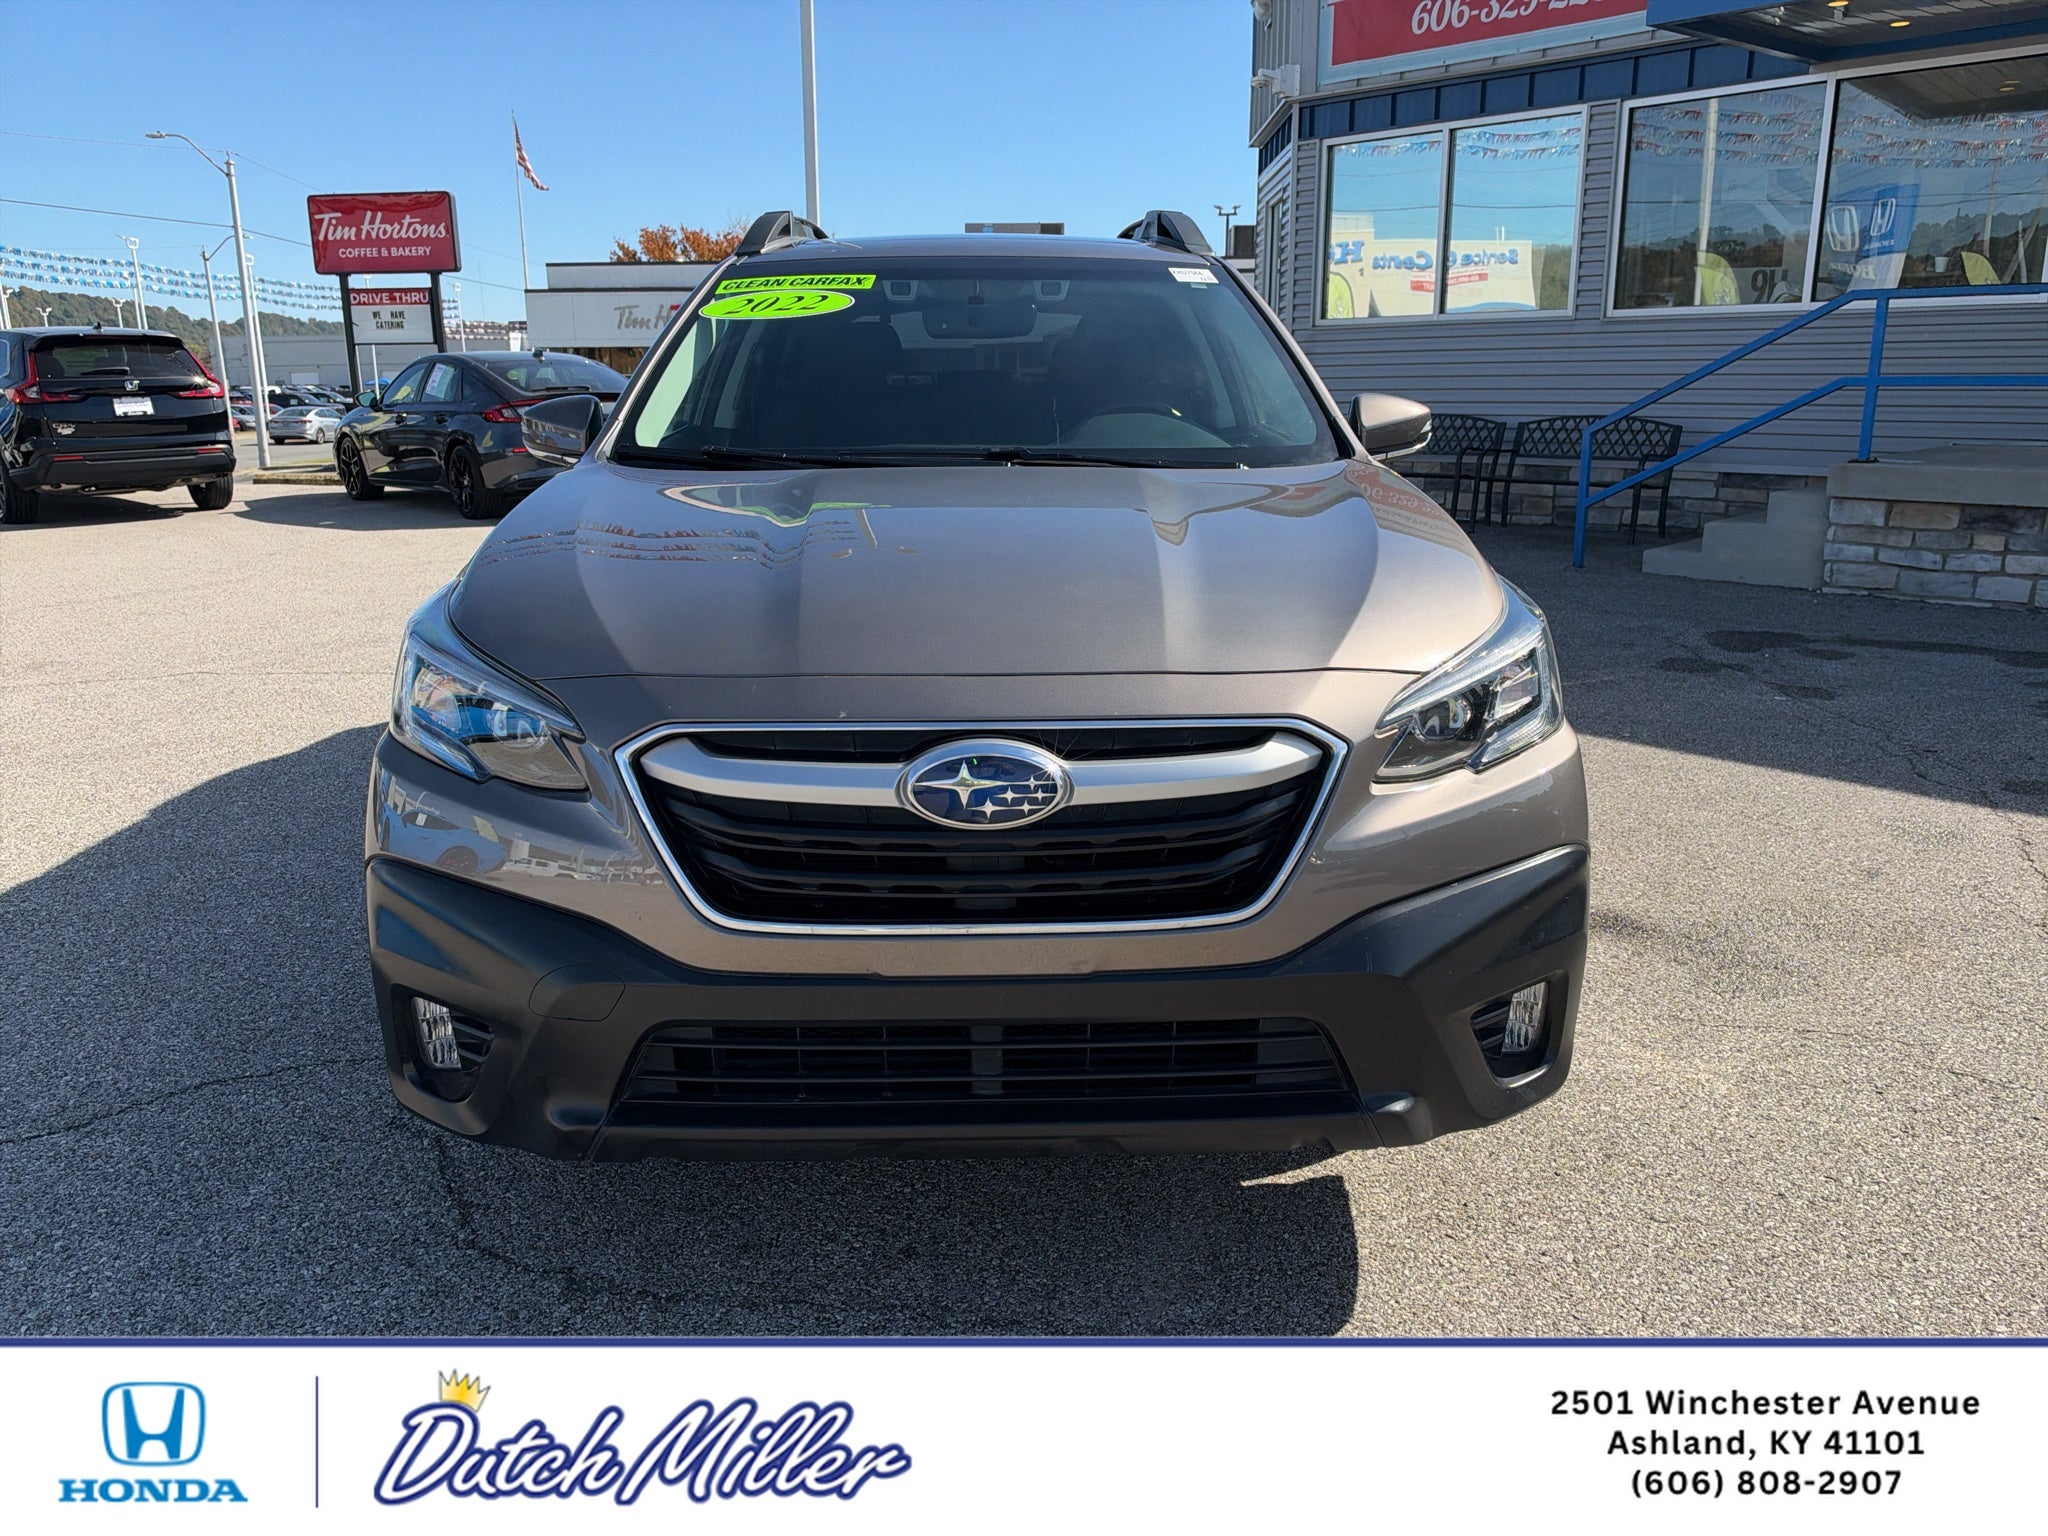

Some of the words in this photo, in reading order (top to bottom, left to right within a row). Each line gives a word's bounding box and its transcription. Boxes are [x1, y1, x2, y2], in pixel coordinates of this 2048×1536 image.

[314, 212, 357, 241] Tim
[359, 210, 447, 240] Hortons
[338, 247, 380, 259] COFFEE
[381, 247, 390, 257] &
[390, 246, 432, 257] BAKERY
[721, 277, 788, 291] CLEAN
[788, 275, 868, 288] CARFAX
[350, 292, 392, 305] DRIVE
[394, 291, 430, 304] THRU
[723, 294, 830, 315] 2022
[372, 310, 382, 320] WE
[390, 310, 406, 320] HAVE
[614, 304, 651, 330] Tim
[375, 320, 405, 331] CATERING
